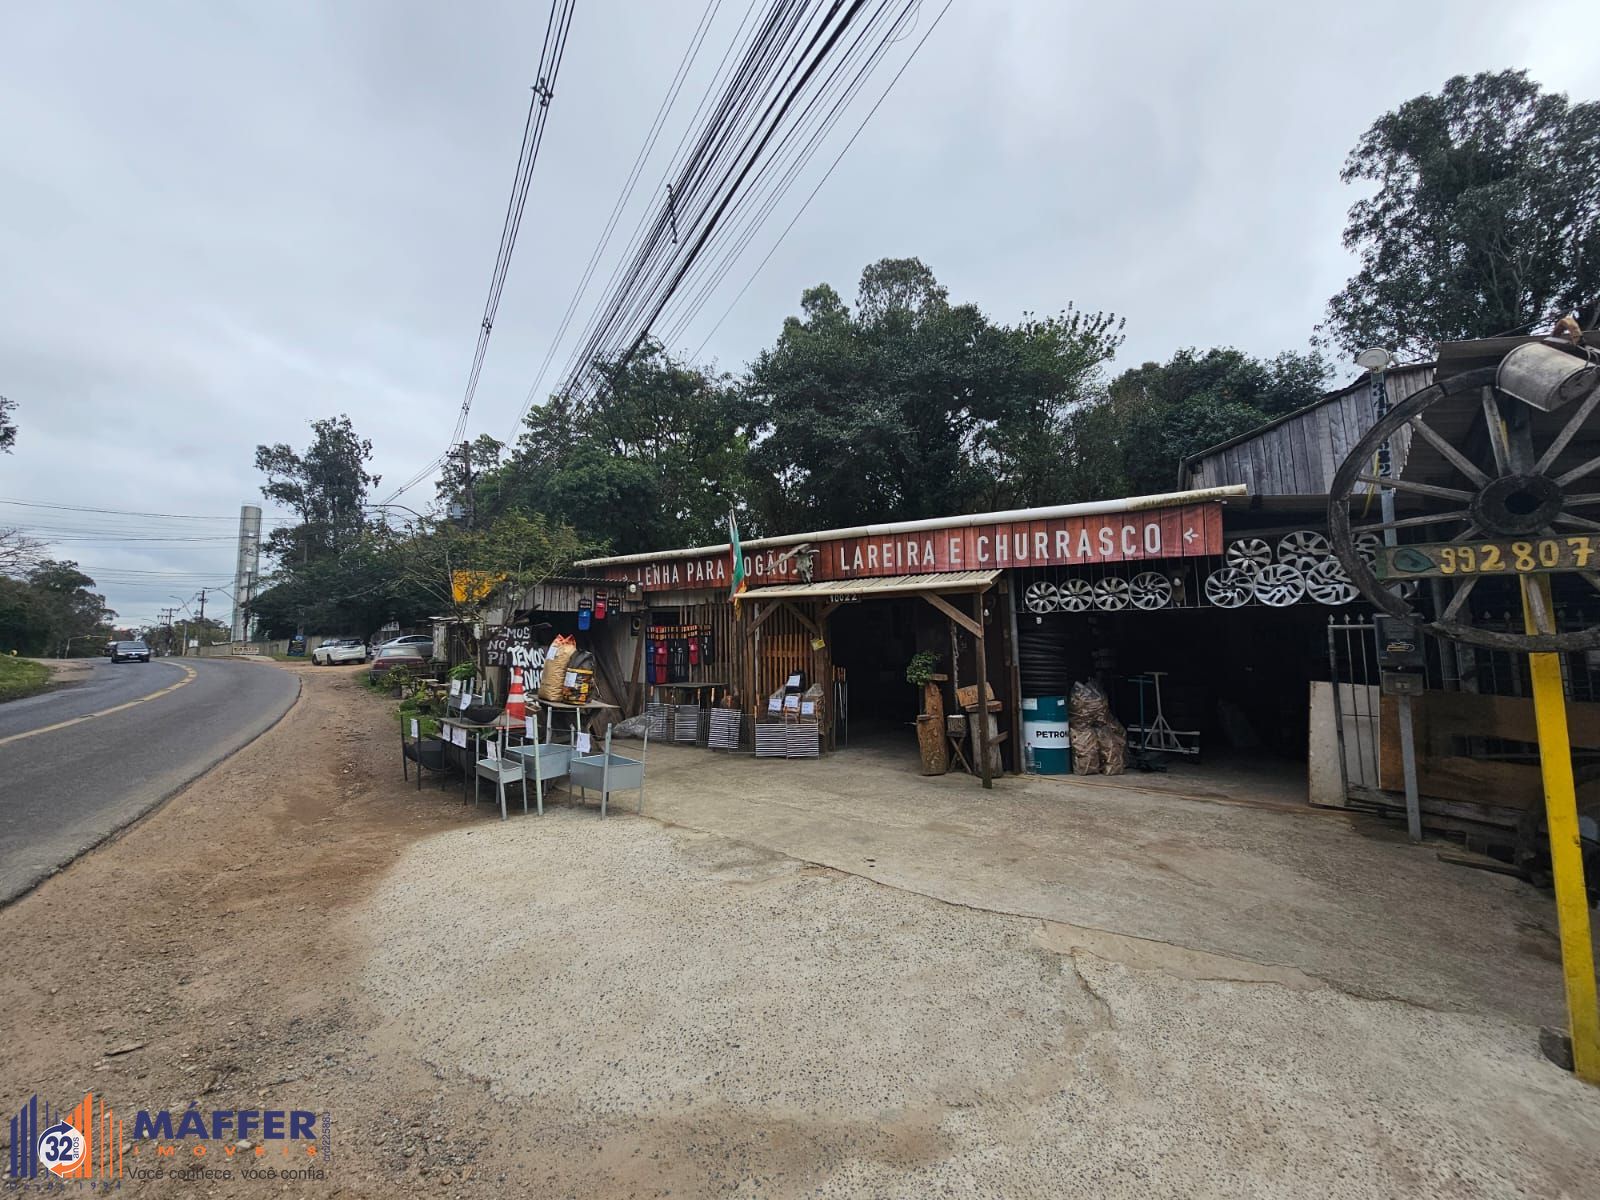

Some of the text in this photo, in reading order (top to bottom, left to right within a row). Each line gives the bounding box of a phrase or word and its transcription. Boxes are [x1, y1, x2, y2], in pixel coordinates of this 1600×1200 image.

[637, 523, 1162, 586] LENHA PARA OGÃO LAREIRA E CHURRASCO
